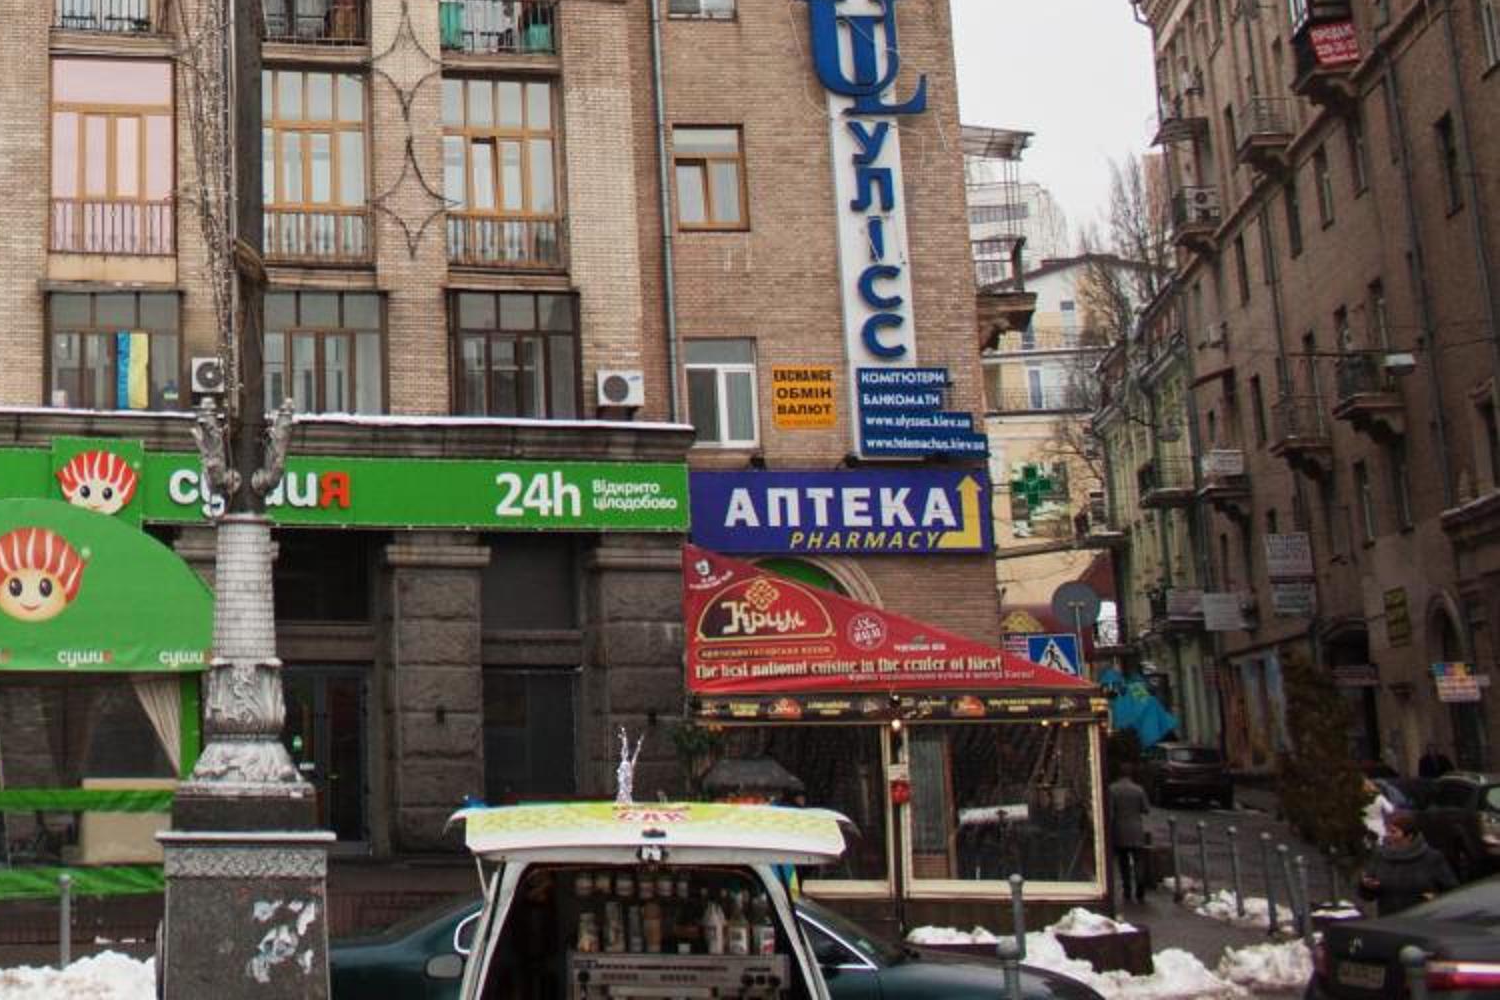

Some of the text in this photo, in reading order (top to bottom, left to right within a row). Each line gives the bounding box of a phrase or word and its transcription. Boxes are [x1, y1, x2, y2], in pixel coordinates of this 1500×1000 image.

[773, 369, 833, 382] EXCHANGE
[776, 387, 833, 400] ОБМІН
[863, 393, 940, 406] БАНКОМАТИ
[777, 403, 833, 415] ВАЛЮТ
[866, 414, 970, 429] www.ulysses.kiev.ua
[495, 470, 581, 517] 24h
[592, 479, 660, 495] Відкрито
[593, 495, 677, 512] цілодобово
[724, 486, 958, 529] АПТЕКА
[789, 531, 940, 550] PHARMACY
[721, 663, 748, 677] best
[751, 660, 807, 676] national
[811, 659, 856, 673] cuisine
[861, 659, 875, 673] in
[878, 658, 900, 672] the
[903, 656, 946, 671] center
